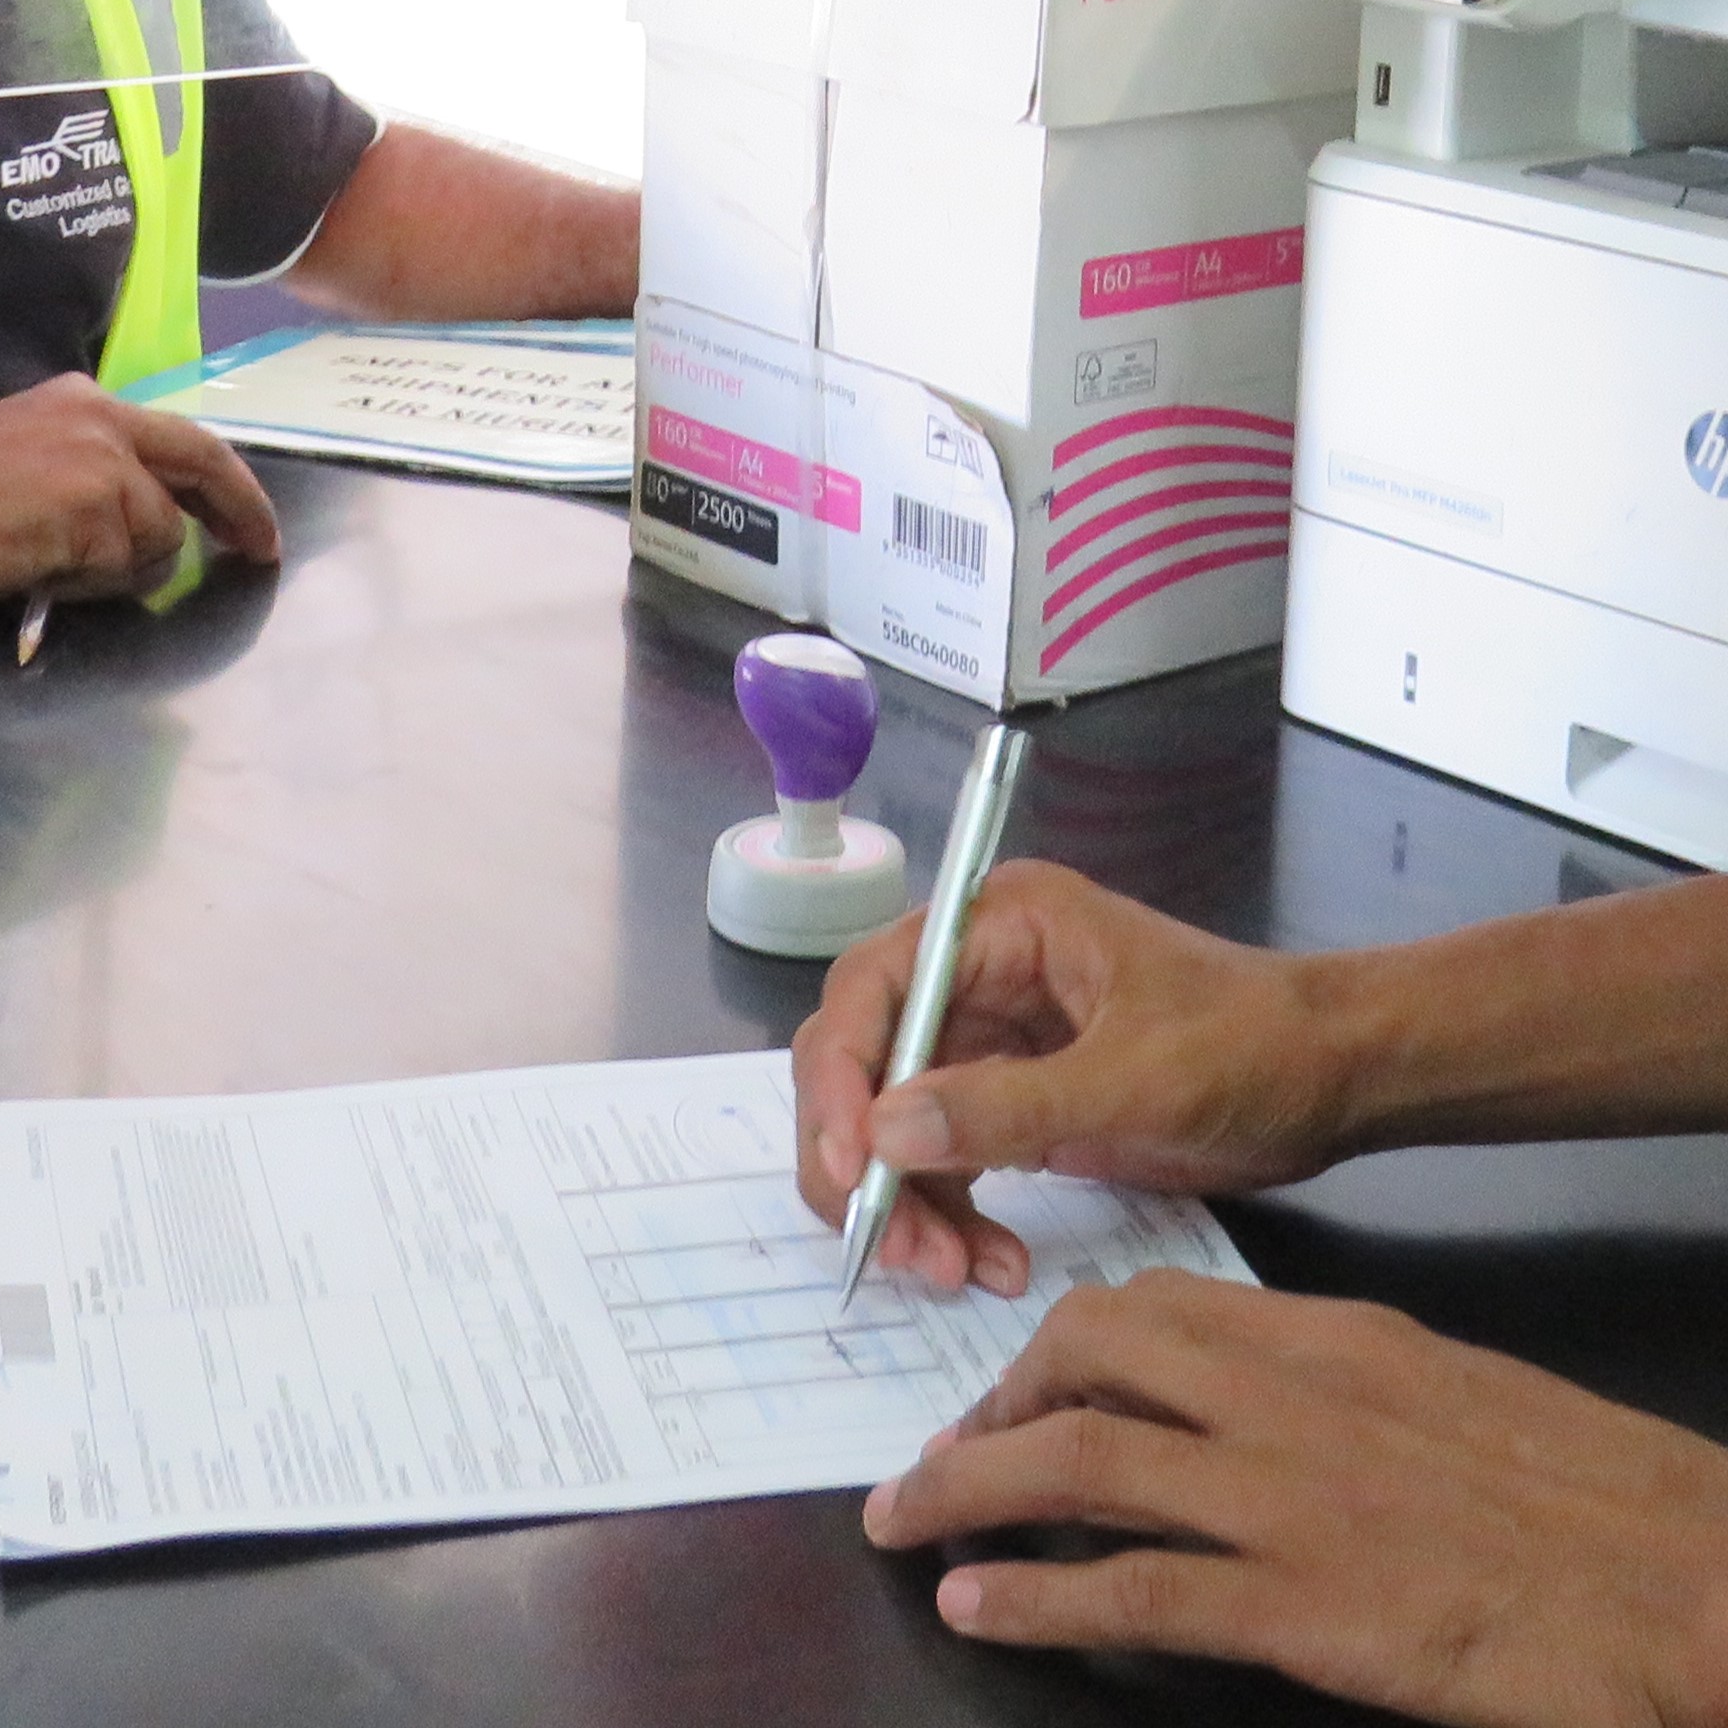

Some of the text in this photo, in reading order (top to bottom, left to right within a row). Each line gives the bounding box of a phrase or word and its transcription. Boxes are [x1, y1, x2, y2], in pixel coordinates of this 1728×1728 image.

[1, 152, 61, 188] EMO
[7, 179, 112, 220] Customized
[1093, 262, 1131, 295] 160
[1194, 249, 1222, 278] A4
[1277, 239, 1288, 265] 5
[650, 343, 744, 400] Performer
[697, 490, 745, 533] 2500
